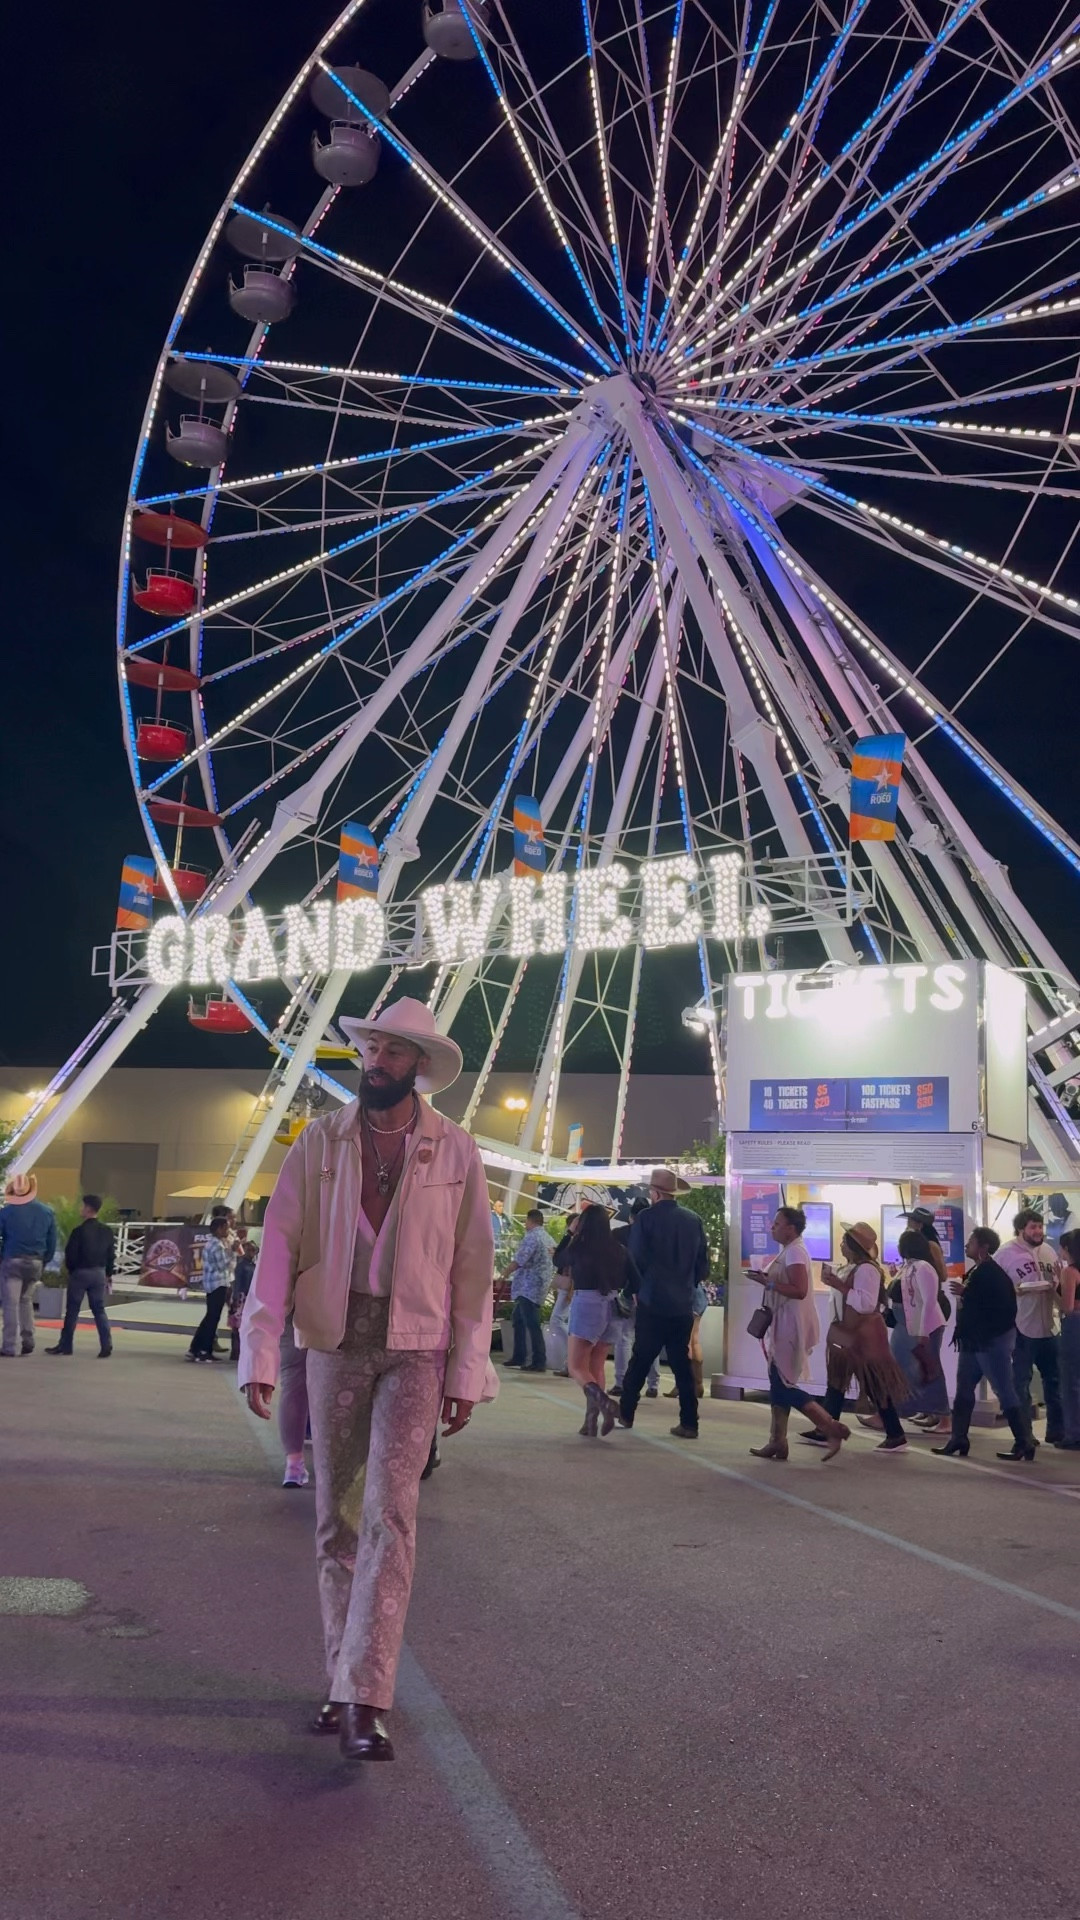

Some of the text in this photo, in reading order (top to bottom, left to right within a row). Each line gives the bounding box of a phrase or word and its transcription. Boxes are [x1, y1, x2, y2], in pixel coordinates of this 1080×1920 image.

[145, 852, 773, 988] GRAND WHEEL
[734, 964, 967, 1020] TICETS
[763, 1084, 828, 1097] 10 TICKETS $5
[861, 1082, 934, 1097] 100 TICKETS $50
[763, 1096, 830, 1110] 40 TICKETS $20
[861, 1097, 900, 1109] FASTPASS
[971, 1121, 978, 1131] 6
[1015, 1261, 1054, 1279] ASTRO
